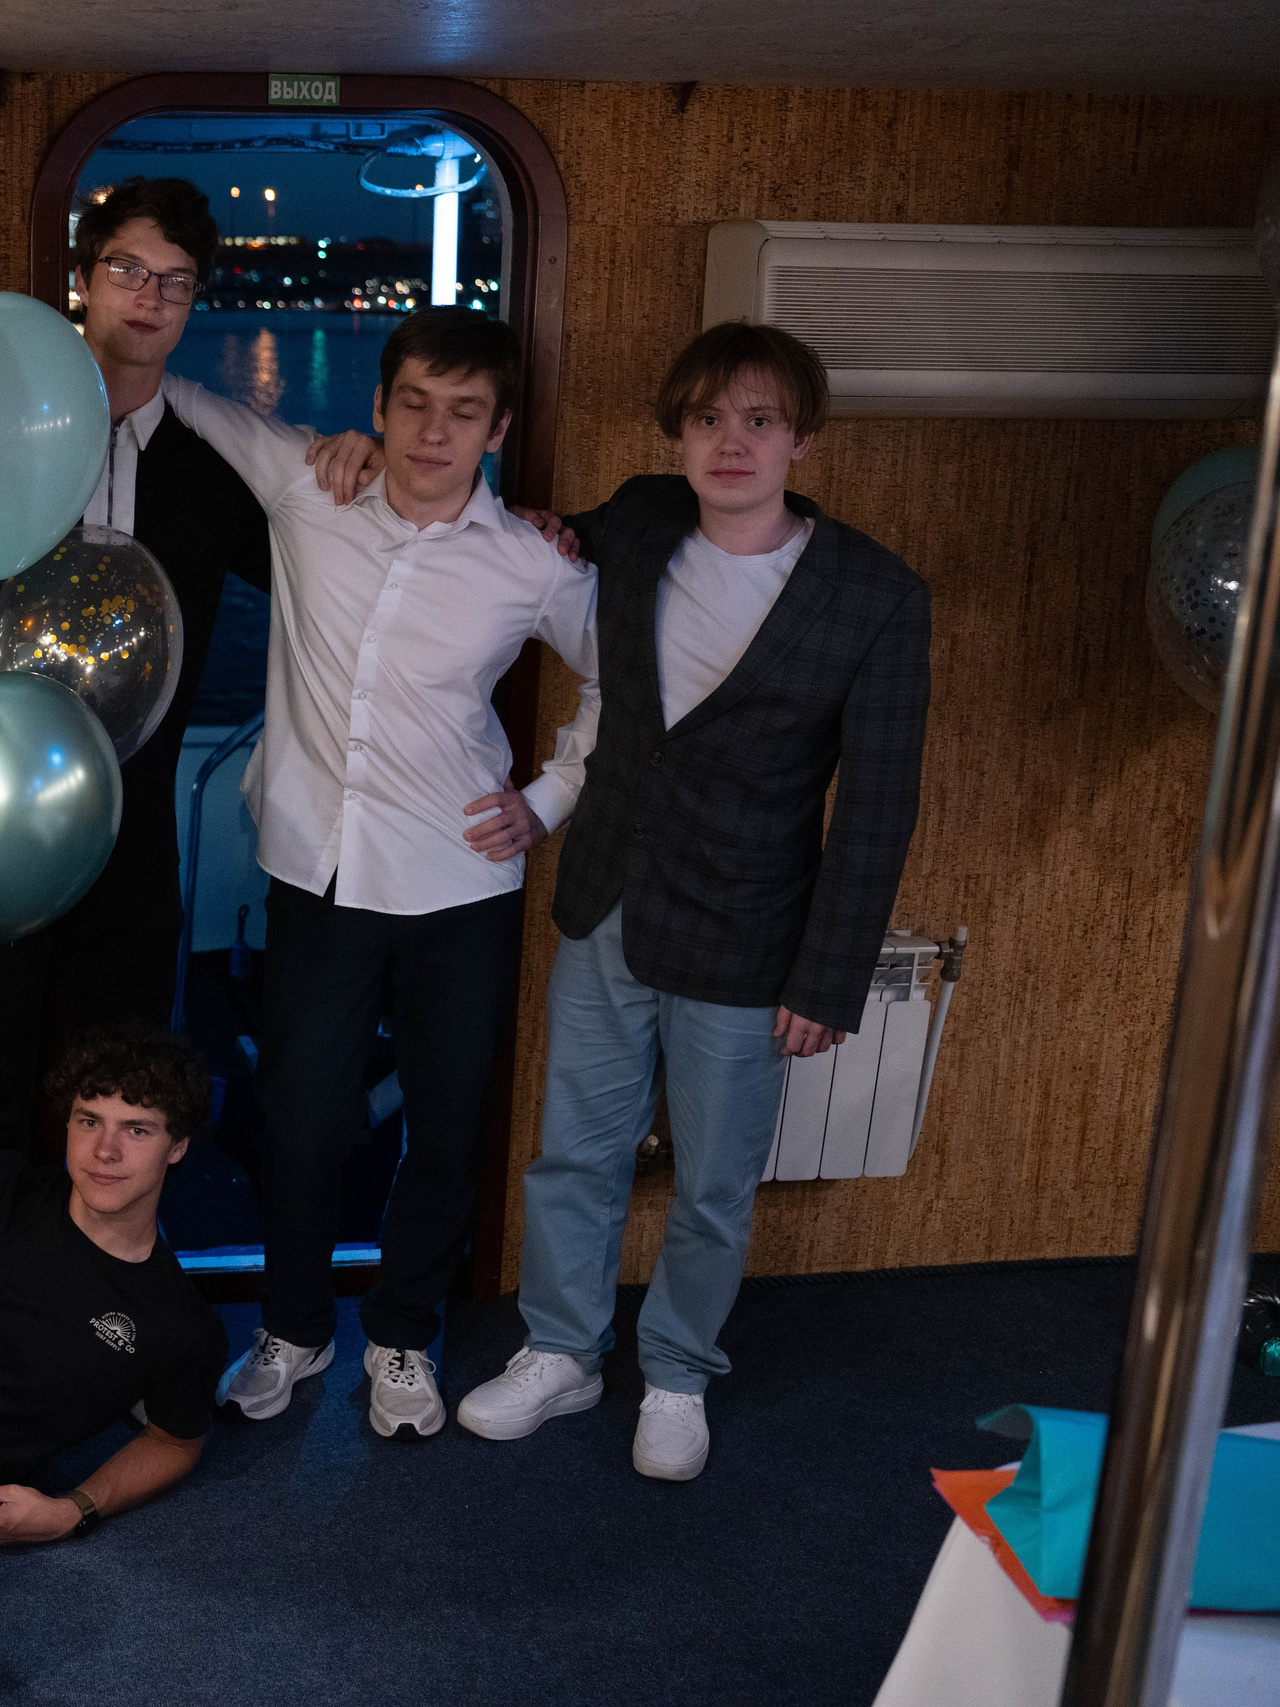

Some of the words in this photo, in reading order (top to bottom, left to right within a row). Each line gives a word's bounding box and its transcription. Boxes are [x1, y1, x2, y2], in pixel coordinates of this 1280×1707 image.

[270, 80, 337, 104] ВЫХОД
[117, 1312, 130, 1321] WAVES
[89, 1317, 119, 1341] PROTEST
[117, 1339, 125, 1347] &
[125, 1344, 136, 1354] CO
[95, 1331, 107, 1341] SURF
[105, 1339, 122, 1352] SUPPLY
